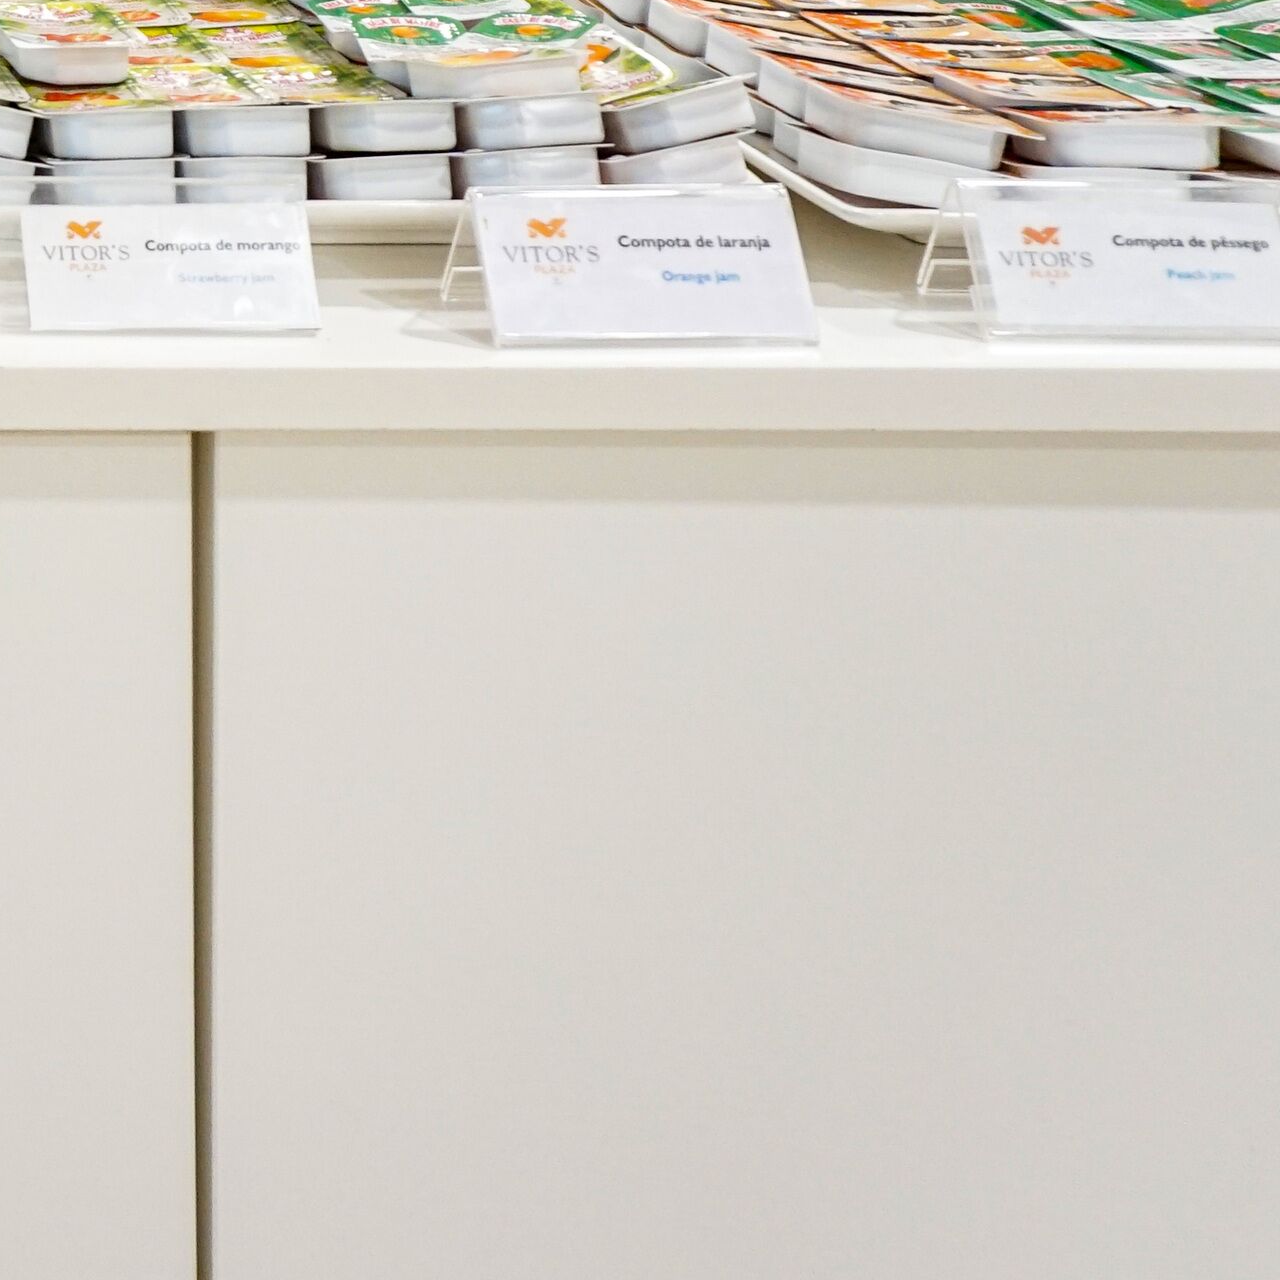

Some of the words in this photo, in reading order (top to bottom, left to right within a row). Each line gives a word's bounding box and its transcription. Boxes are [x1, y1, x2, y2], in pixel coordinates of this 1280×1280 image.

[144, 239, 212, 255] Compota
[215, 239, 233, 252] de
[237, 239, 302, 255] morango
[617, 234, 692, 252] Compota
[695, 235, 714, 249] de
[717, 235, 771, 252] laranja
[1112, 234, 1184, 251] Compota
[1188, 235, 1206, 248] de
[41, 244, 131, 262] VITOR'S
[502, 244, 601, 265] VITOR'S
[998, 250, 1095, 269] VITOR'S
